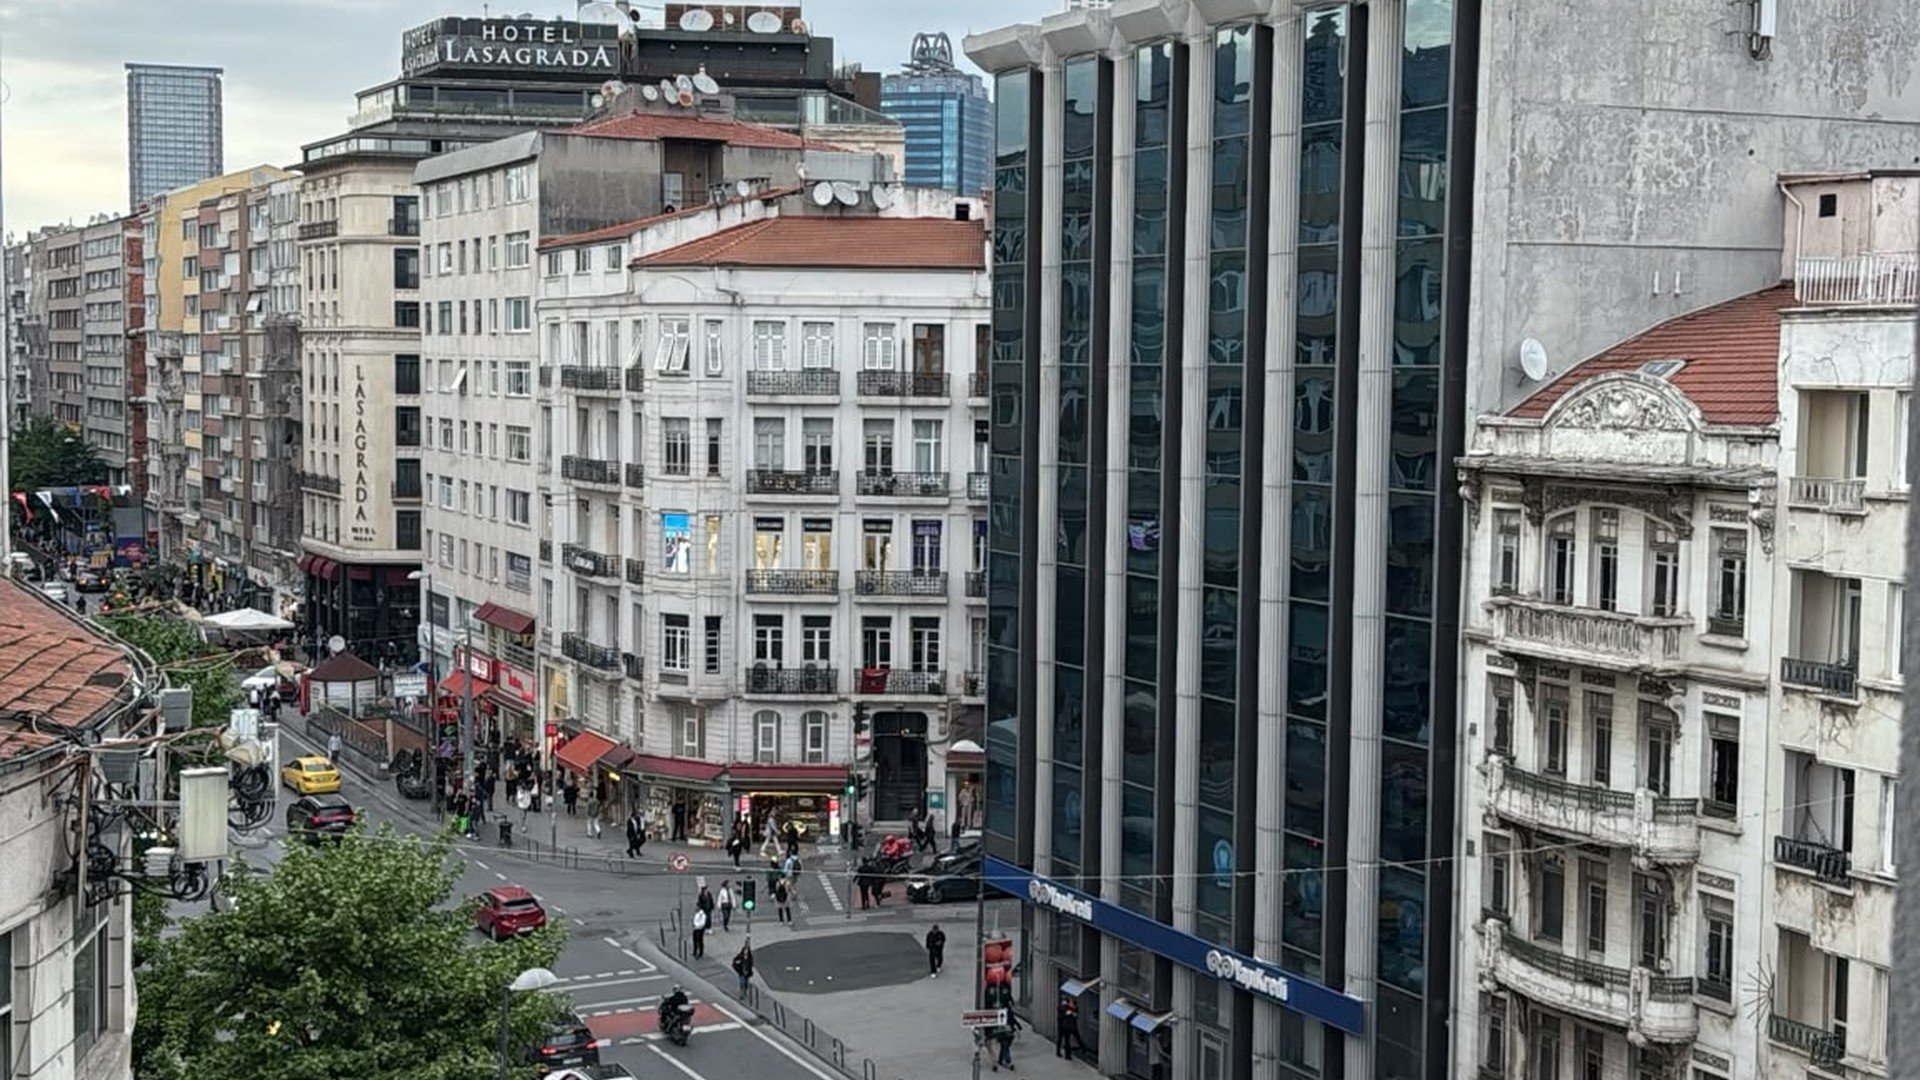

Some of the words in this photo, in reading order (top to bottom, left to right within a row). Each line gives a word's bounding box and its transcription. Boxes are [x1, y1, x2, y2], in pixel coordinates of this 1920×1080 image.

[482, 25, 573, 43] HOTEL
[445, 40, 612, 67] LASAGRADA
[355, 365, 368, 521] LASAGRADA
